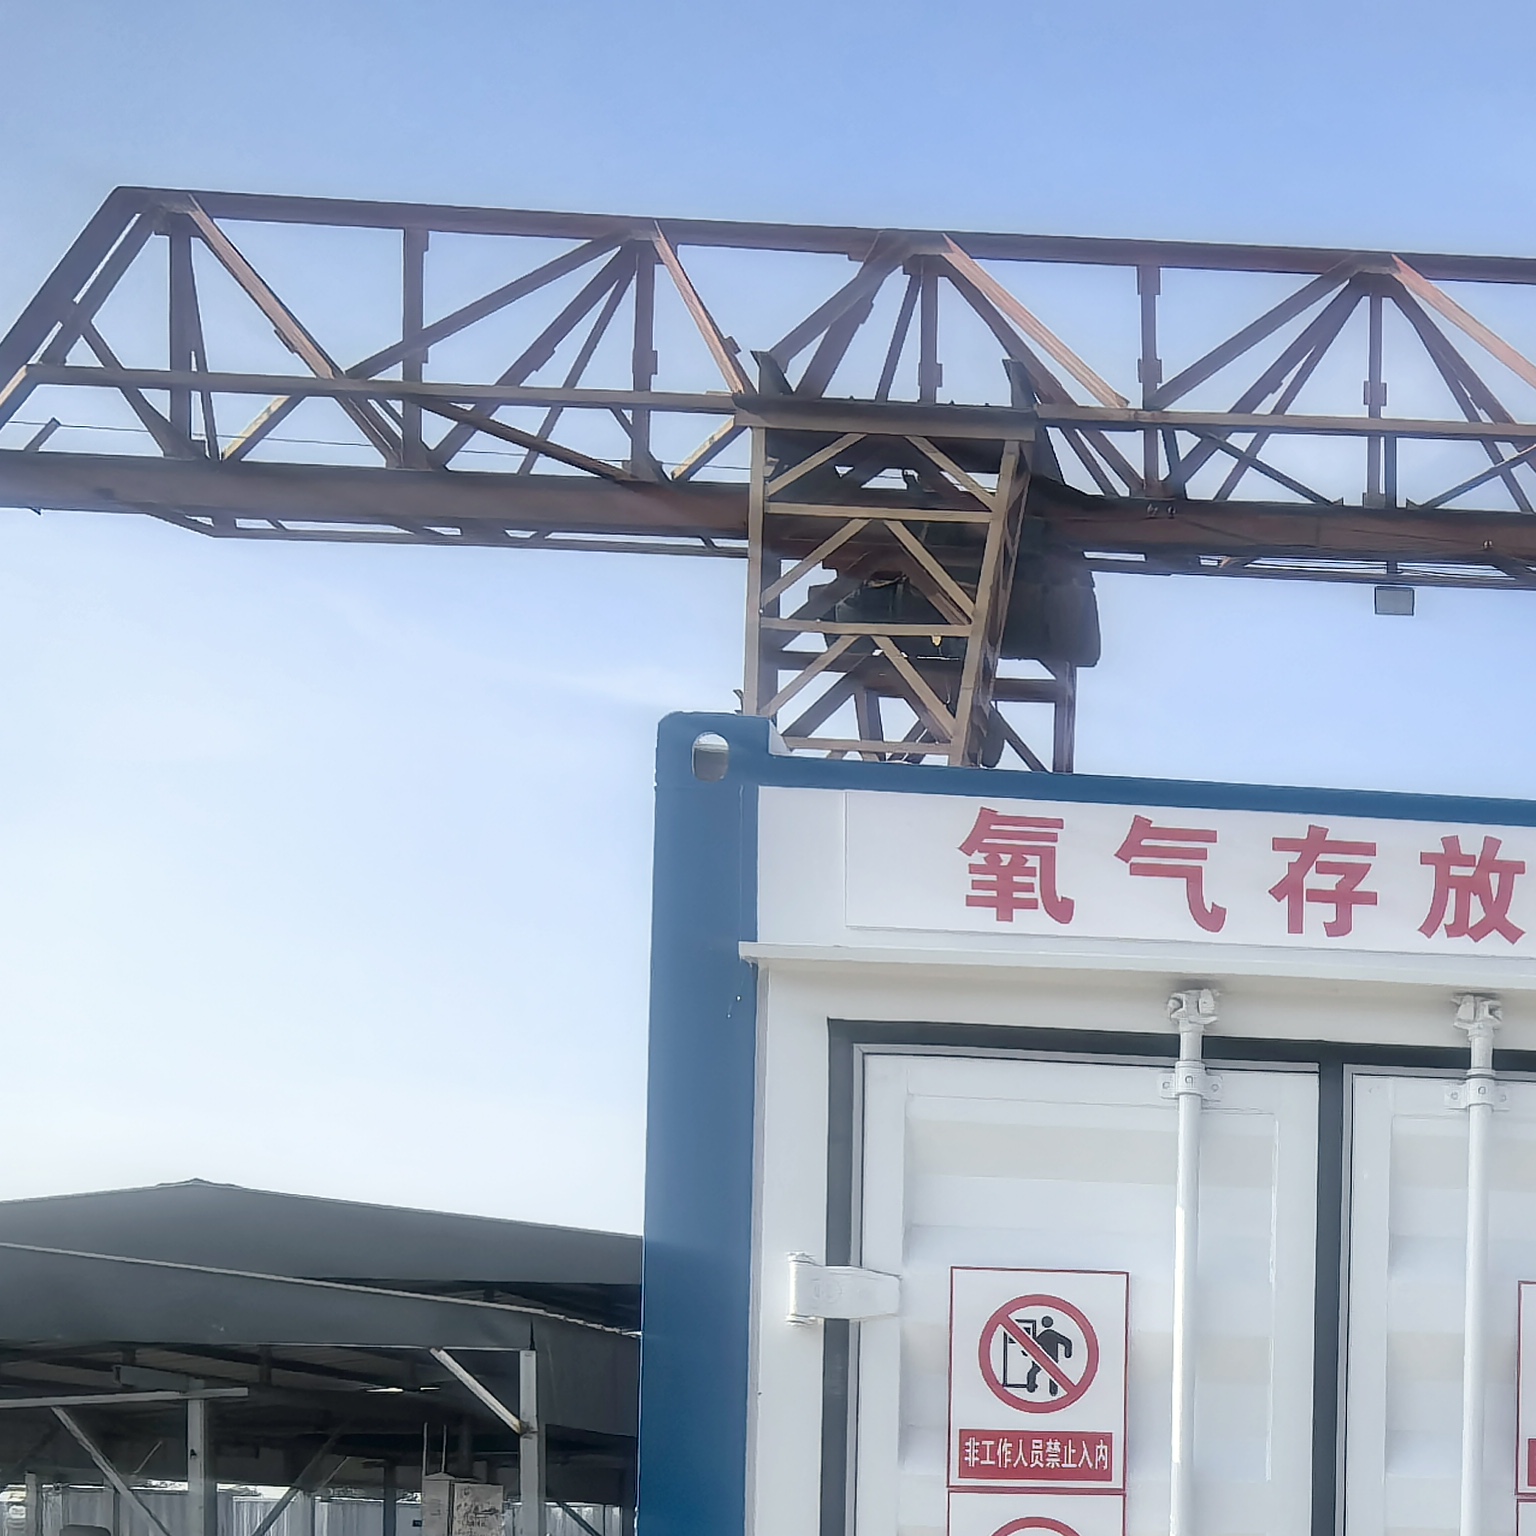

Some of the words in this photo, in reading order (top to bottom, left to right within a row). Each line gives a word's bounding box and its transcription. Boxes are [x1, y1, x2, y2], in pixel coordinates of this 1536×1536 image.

[964, 1436, 1108, 1471] 非工作人员禁止入内
